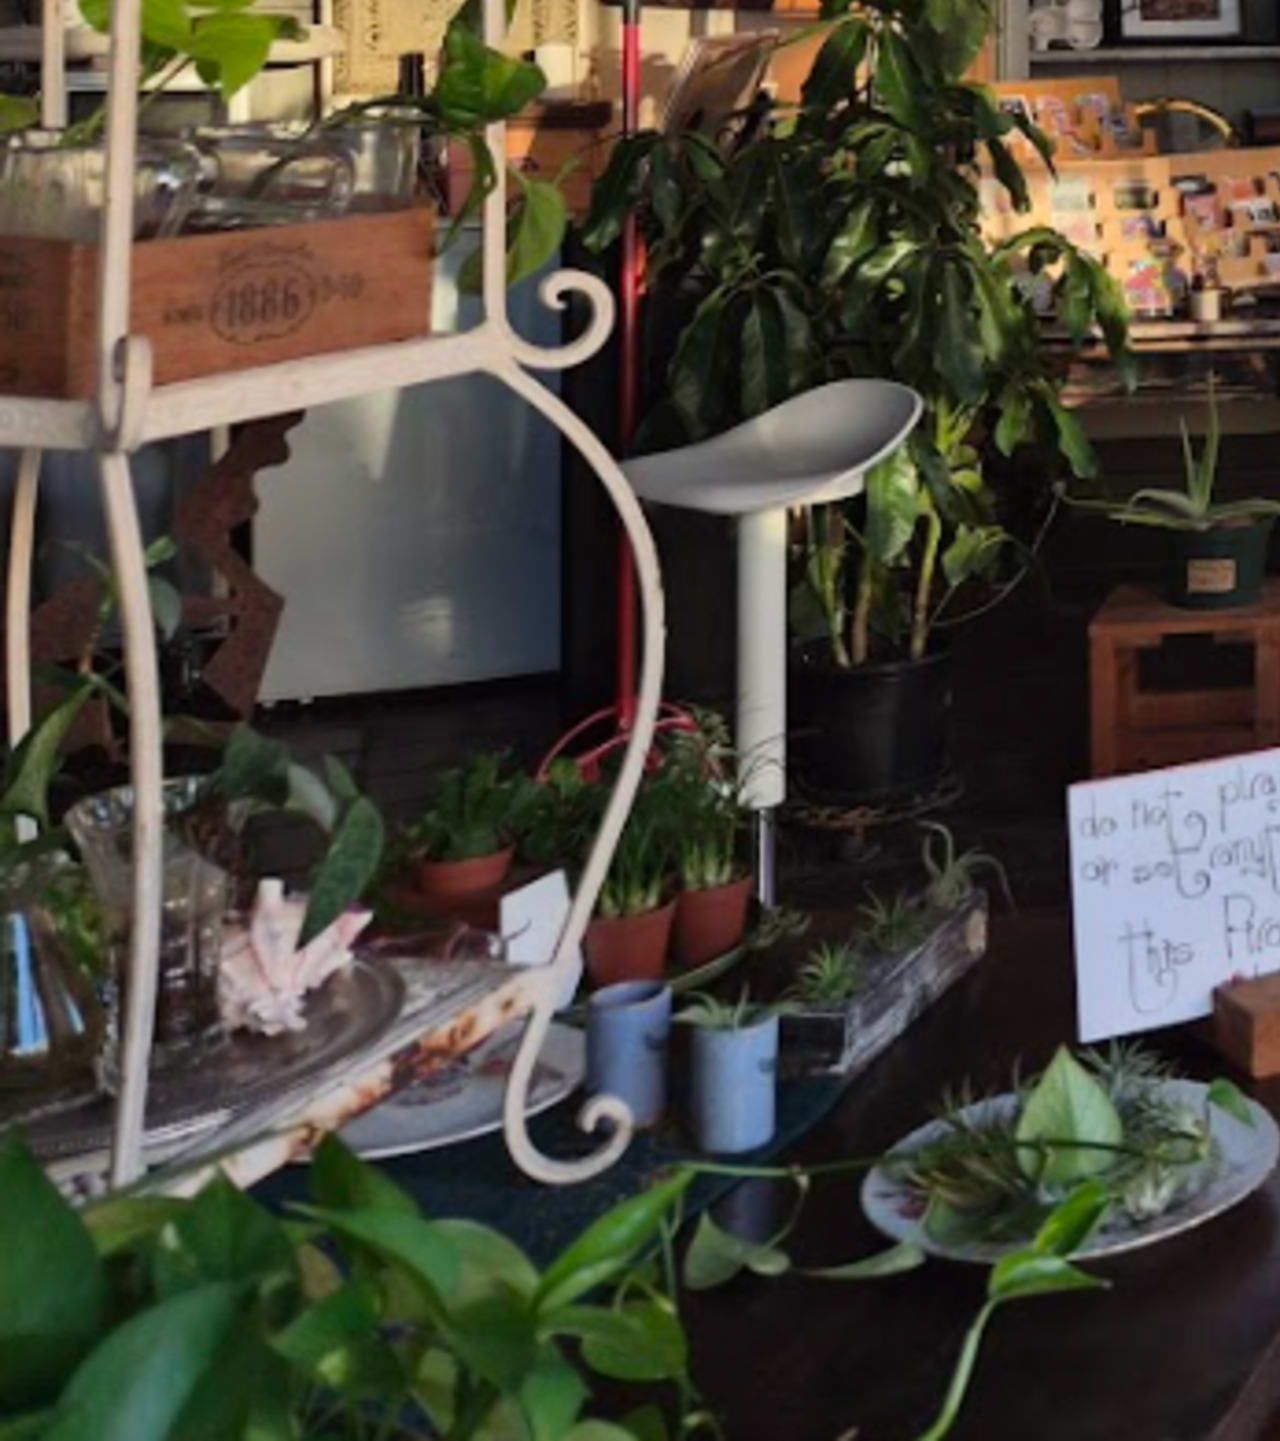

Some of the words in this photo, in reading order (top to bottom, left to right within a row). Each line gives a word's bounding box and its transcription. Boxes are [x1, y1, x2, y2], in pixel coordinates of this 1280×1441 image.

[225, 276, 301, 329] 1886
[1080, 795, 1118, 839] do
[1131, 782, 1207, 852] not
[1080, 856, 1118, 885] or
